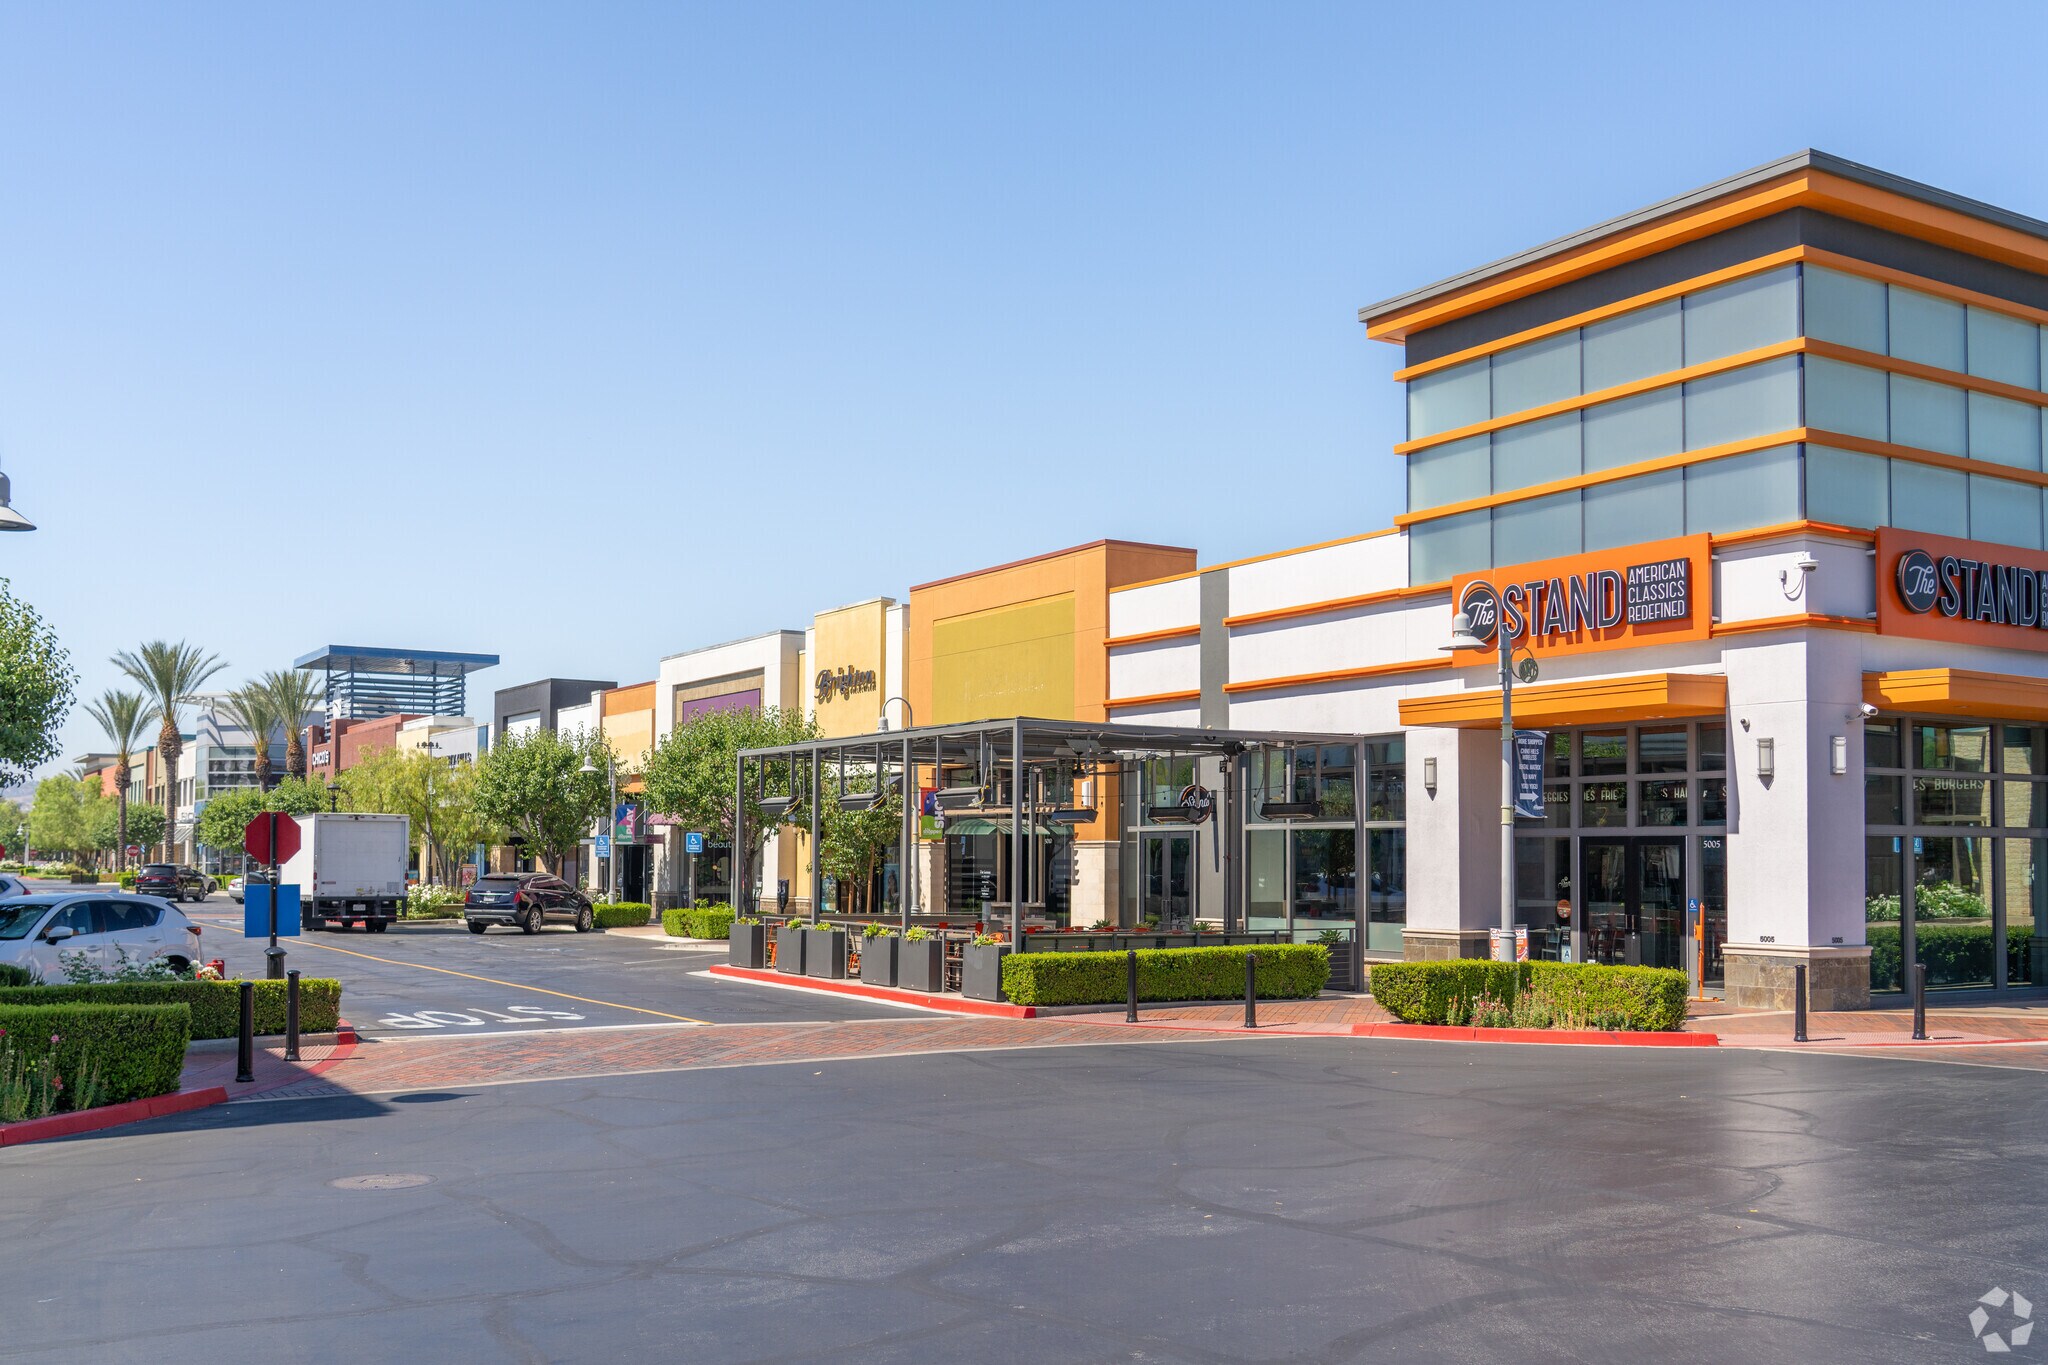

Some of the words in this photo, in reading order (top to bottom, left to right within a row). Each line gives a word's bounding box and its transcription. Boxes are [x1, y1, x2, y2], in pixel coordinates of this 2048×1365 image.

[1628, 560, 1685, 586] AMERICAN
[1628, 580, 1685, 604] CLASSICS
[1906, 565, 1935, 596] The
[1940, 555, 2038, 627] STAND
[1467, 598, 1495, 628] The
[1501, 569, 1623, 640] STAND
[1628, 601, 1685, 622] REDEFINED
[814, 664, 876, 700] Brighton
[1543, 791, 1568, 802] EGGIES
[1601, 789, 1618, 801] FRIE
[1934, 778, 1984, 791] BURGERS
[626, 807, 634, 834] PLAY
[934, 793, 945, 829] SHO
[707, 839, 732, 848] beaut
[1703, 840, 1721, 849] 5005
[1760, 935, 1775, 943] 5005
[1831, 936, 1844, 944] 5005
[378, 1005, 586, 1029] STOP
